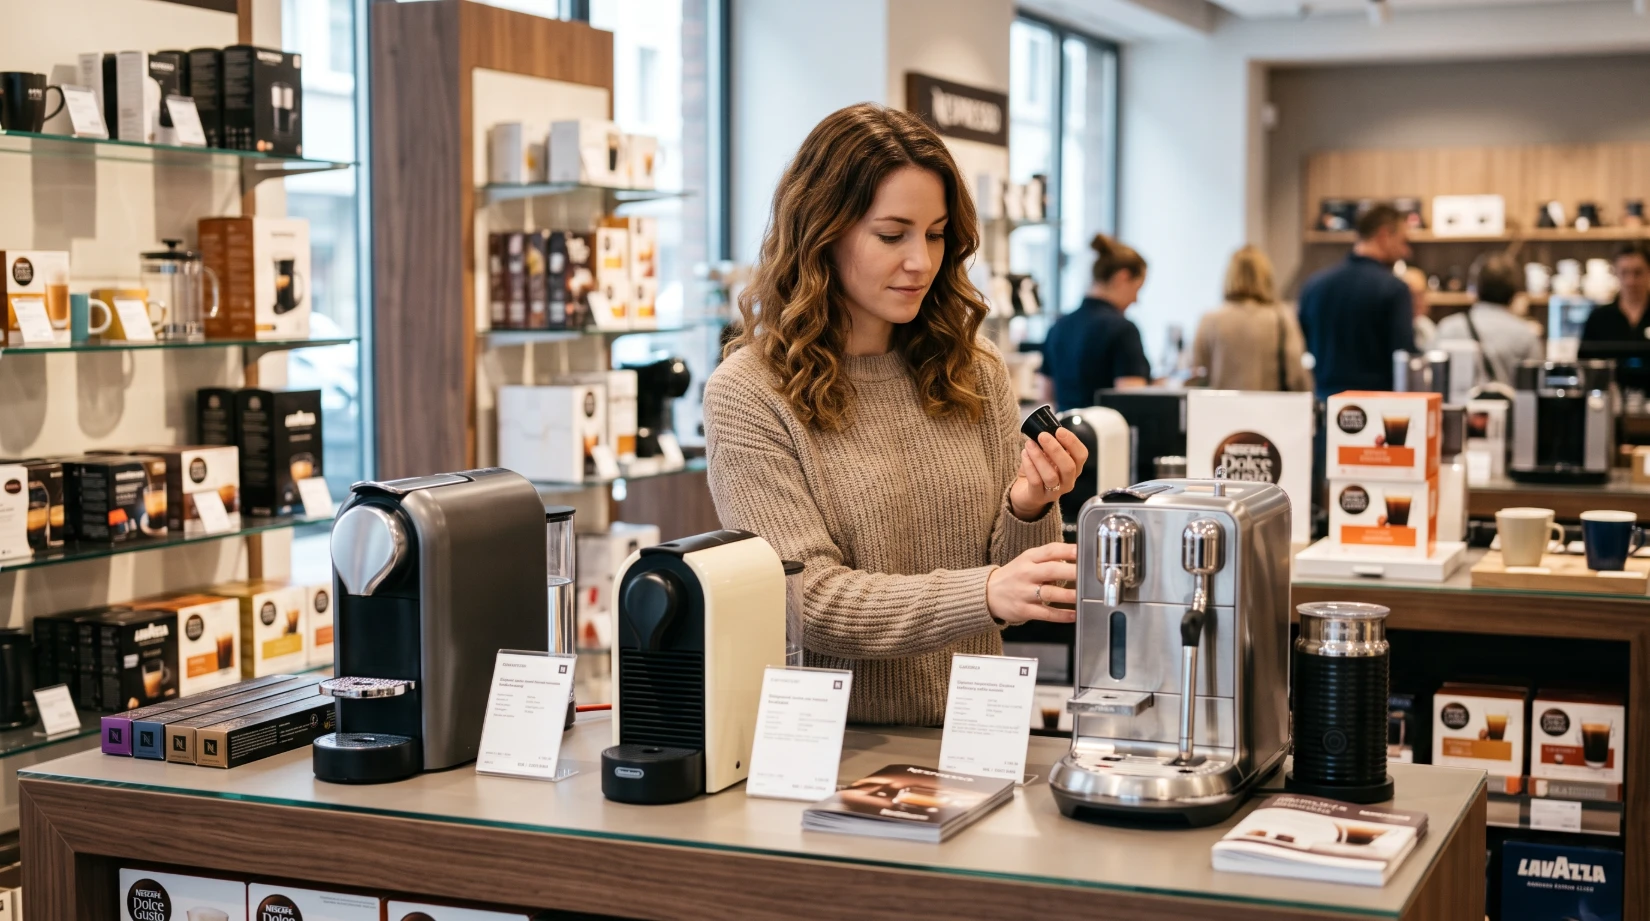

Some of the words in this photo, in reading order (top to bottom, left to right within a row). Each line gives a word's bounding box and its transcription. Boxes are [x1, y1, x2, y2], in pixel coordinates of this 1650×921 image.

[1221, 453, 1273, 473] Dolce
[1517, 855, 1606, 884] LAVAZZA
[133, 896, 164, 912] Dolce
[133, 908, 165, 921] Gusto
